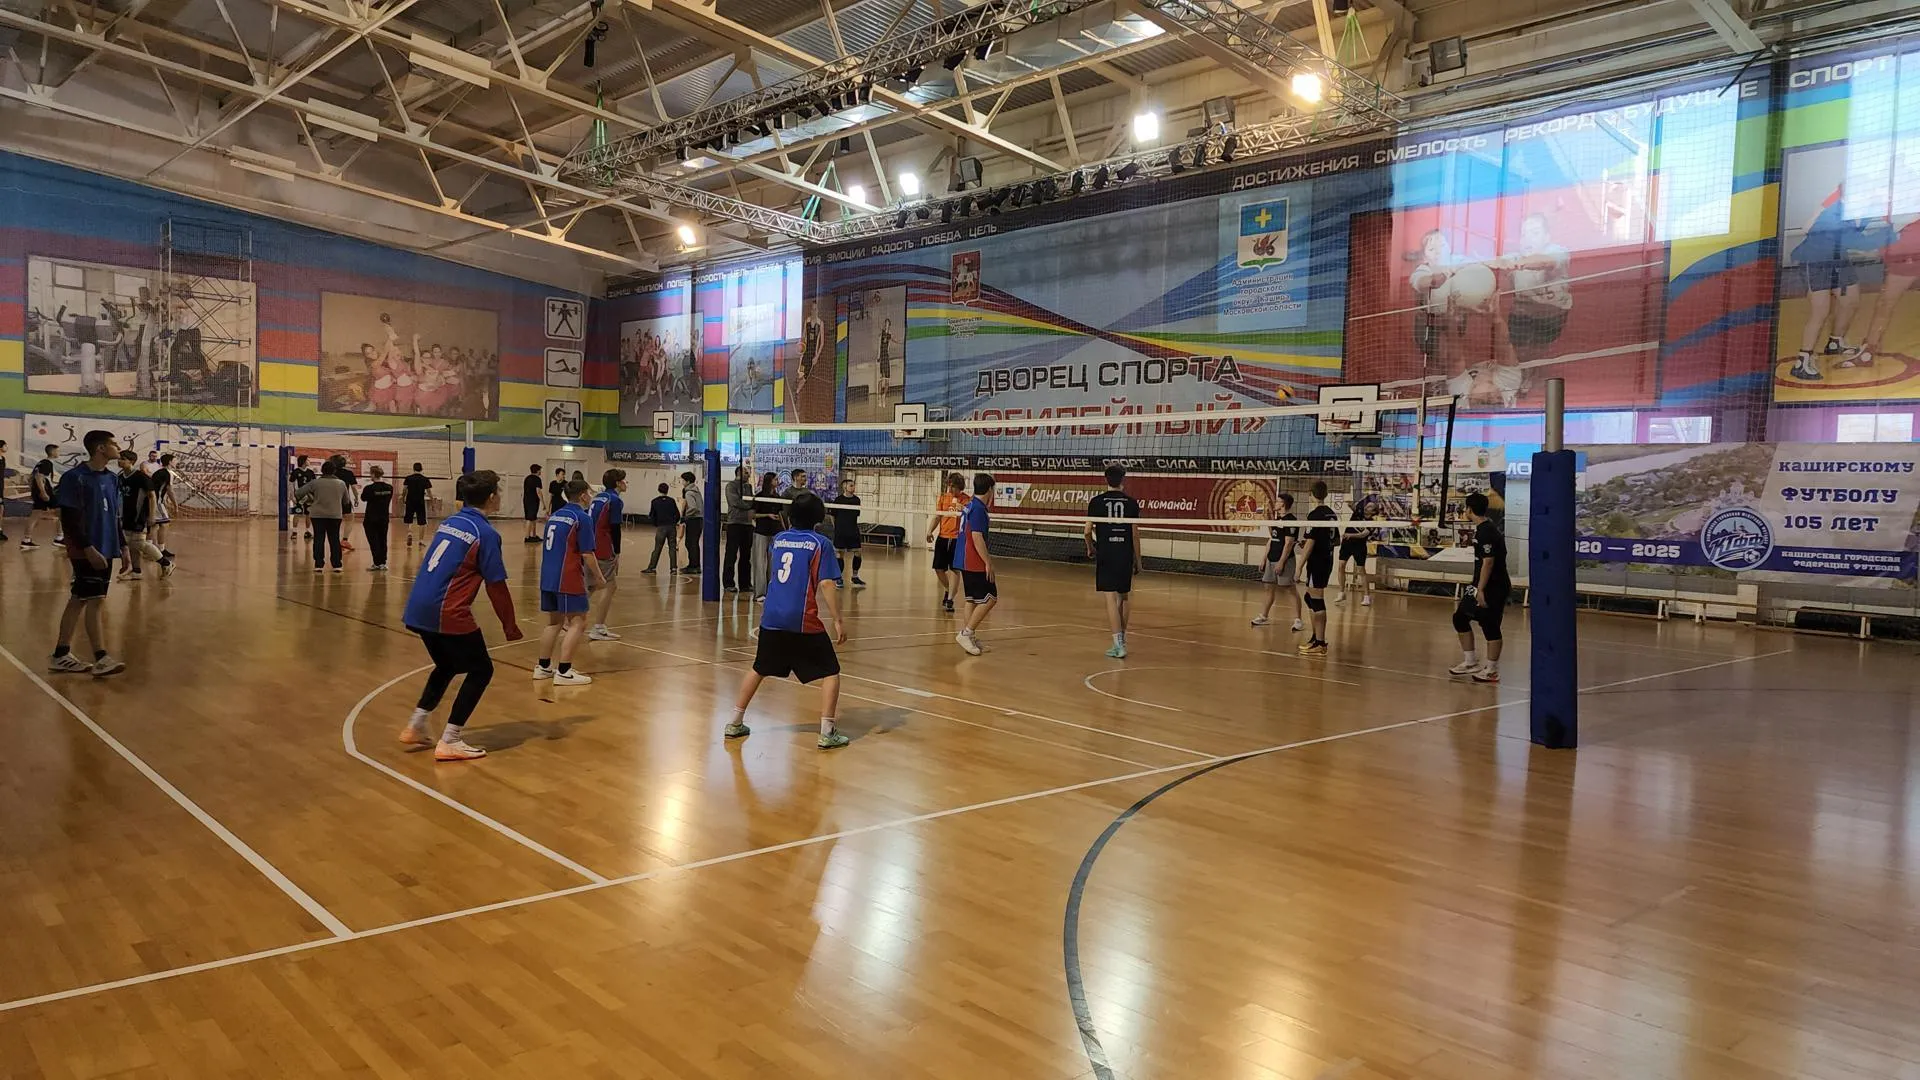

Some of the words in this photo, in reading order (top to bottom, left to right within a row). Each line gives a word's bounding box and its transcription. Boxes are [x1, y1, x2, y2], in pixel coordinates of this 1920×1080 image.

[1789, 54, 1896, 88] СПОРТ
[1232, 155, 1360, 191] ДОСТИЖЕНИЯ
[1373, 135, 1487, 164] СМЕЛОСТЬ
[1504, 112, 1596, 142] РЕКОРД
[827, 248, 866, 262] ЭМОЦИИ
[871, 239, 914, 255] РАДОСТЬ
[921, 231, 962, 247] ПОБЕДА
[969, 223, 998, 239] ЦЕЛЬ
[975, 363, 1089, 398] ДВОРЕЦ
[1098, 355, 1243, 387] СПОРТА
[845, 456, 910, 466] ДОСТИЖЕНИЯ
[915, 456, 970, 467] СМЕЛОСТЬ
[977, 456, 1021, 468] РЕКОРД
[1031, 457, 1092, 470] БУДУЩЕЕ
[1156, 459, 1200, 470] СИЛА
[1210, 459, 1310, 472] ДИНАМИКА
[1031, 489, 1062, 502] ОДНА
[1148, 498, 1198, 511] команда!
[1781, 487, 1898, 503] ФУТБОЛУ
[1105, 501, 1125, 524] 10
[1784, 515, 1822, 529] 105
[546, 525, 557, 550] 5
[427, 539, 450, 572] 4
[1632, 543, 1681, 558] 2025
[777, 552, 794, 584] 3
